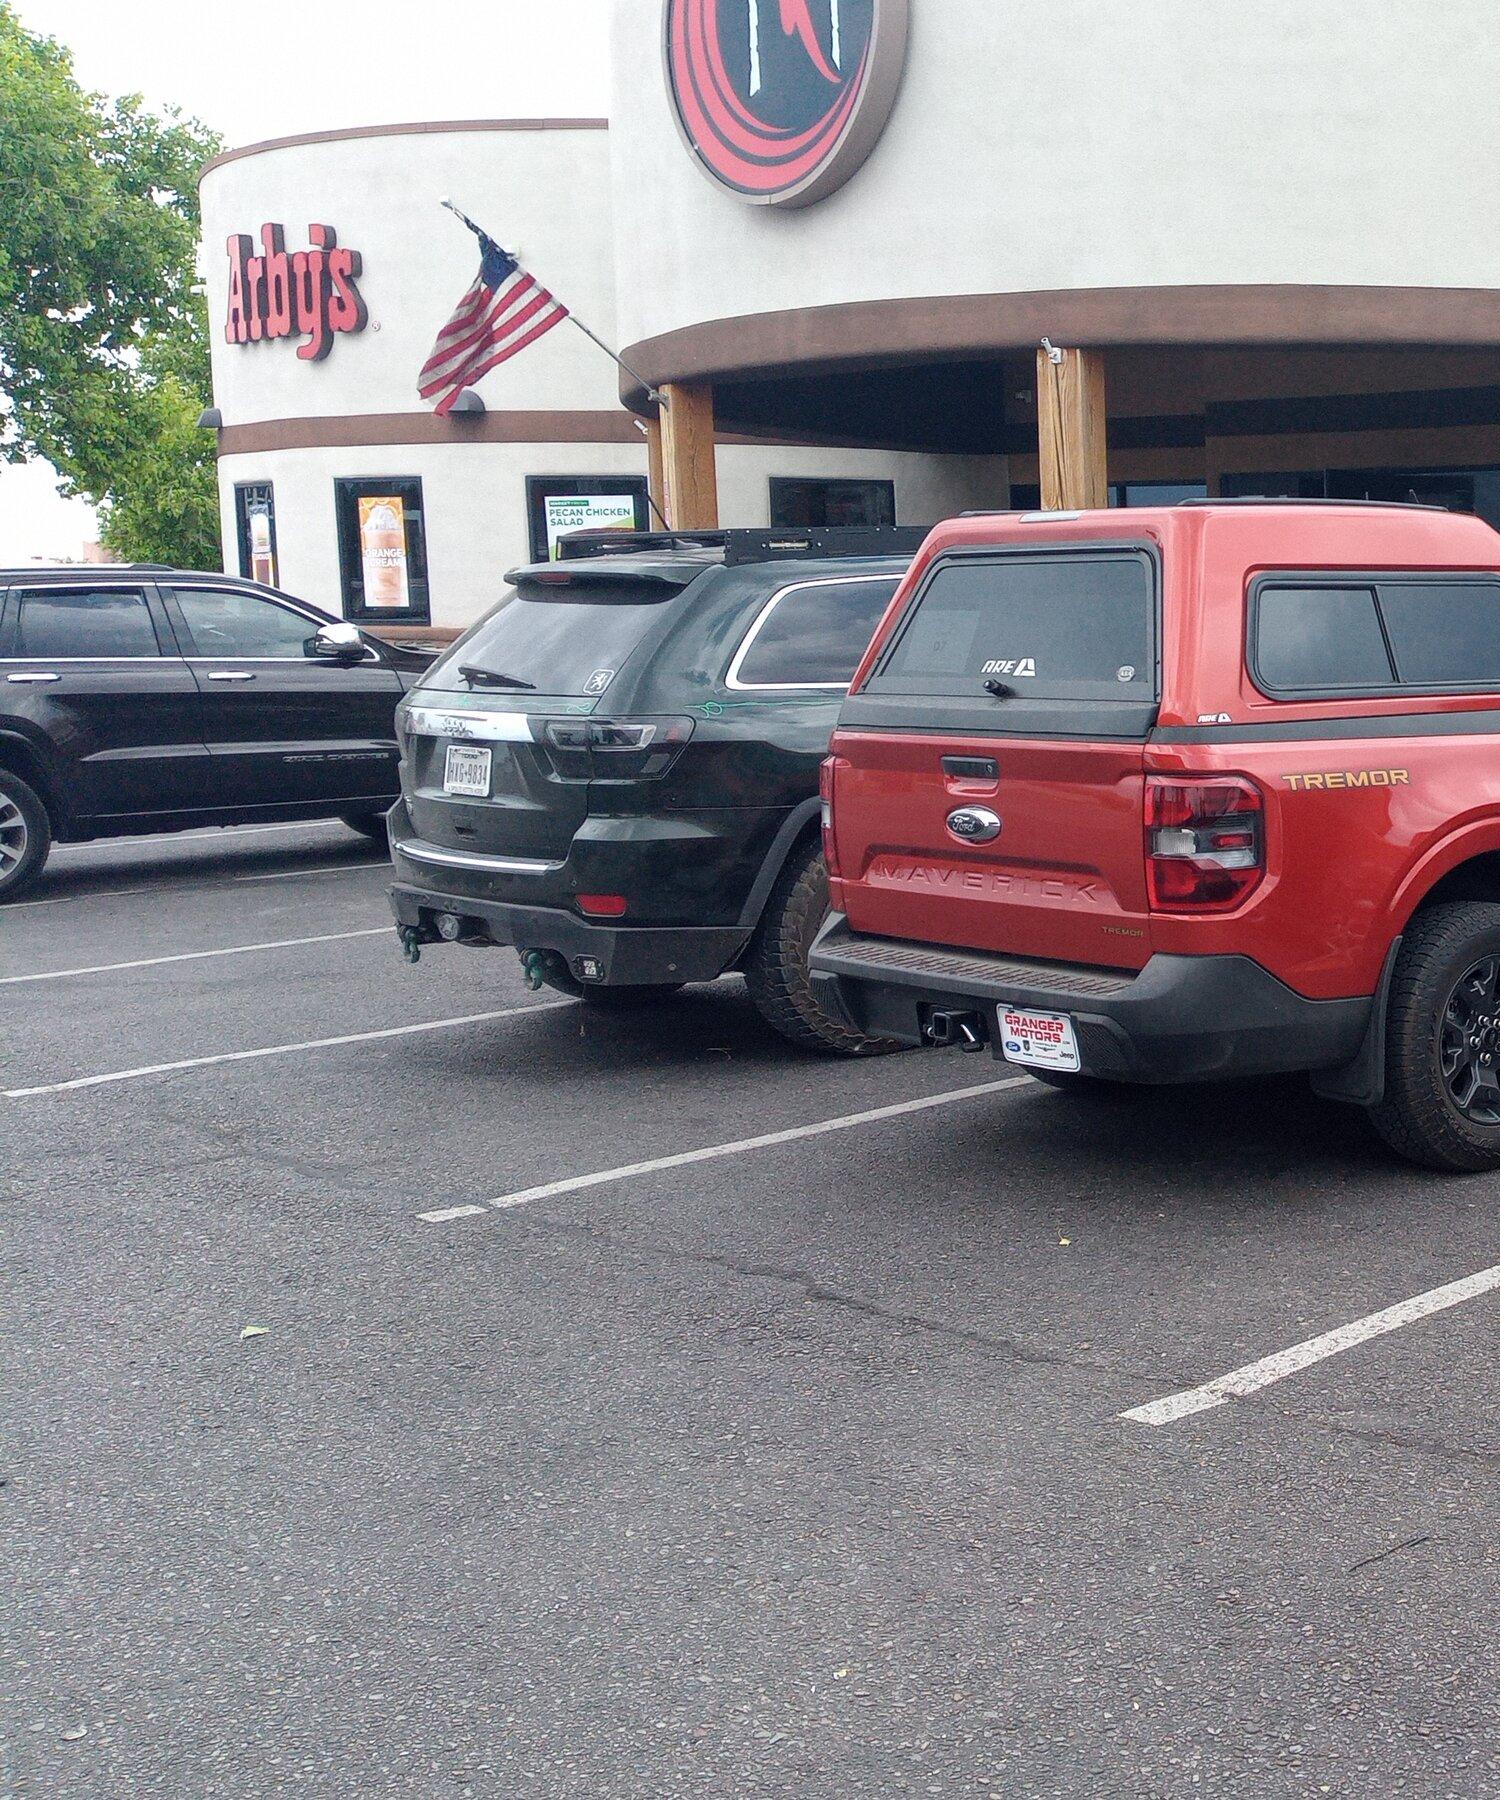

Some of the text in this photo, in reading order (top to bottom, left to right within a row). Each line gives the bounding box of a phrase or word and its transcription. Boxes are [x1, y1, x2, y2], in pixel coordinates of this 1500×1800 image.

[225, 222, 369, 361] Arby's
[549, 508, 631, 517] PECAN CHICKEN
[550, 518, 584, 527] SALAD
[364, 548, 404, 558] ORANGE
[1282, 769, 1409, 791] TREMOR
[952, 815, 975, 833] Ford
[876, 862, 1098, 903] MAVERICK
[1102, 926, 1143, 937] TREMOR
[1005, 1014, 1064, 1033] GRANGER
[1010, 1026, 1061, 1044] MOTORS
